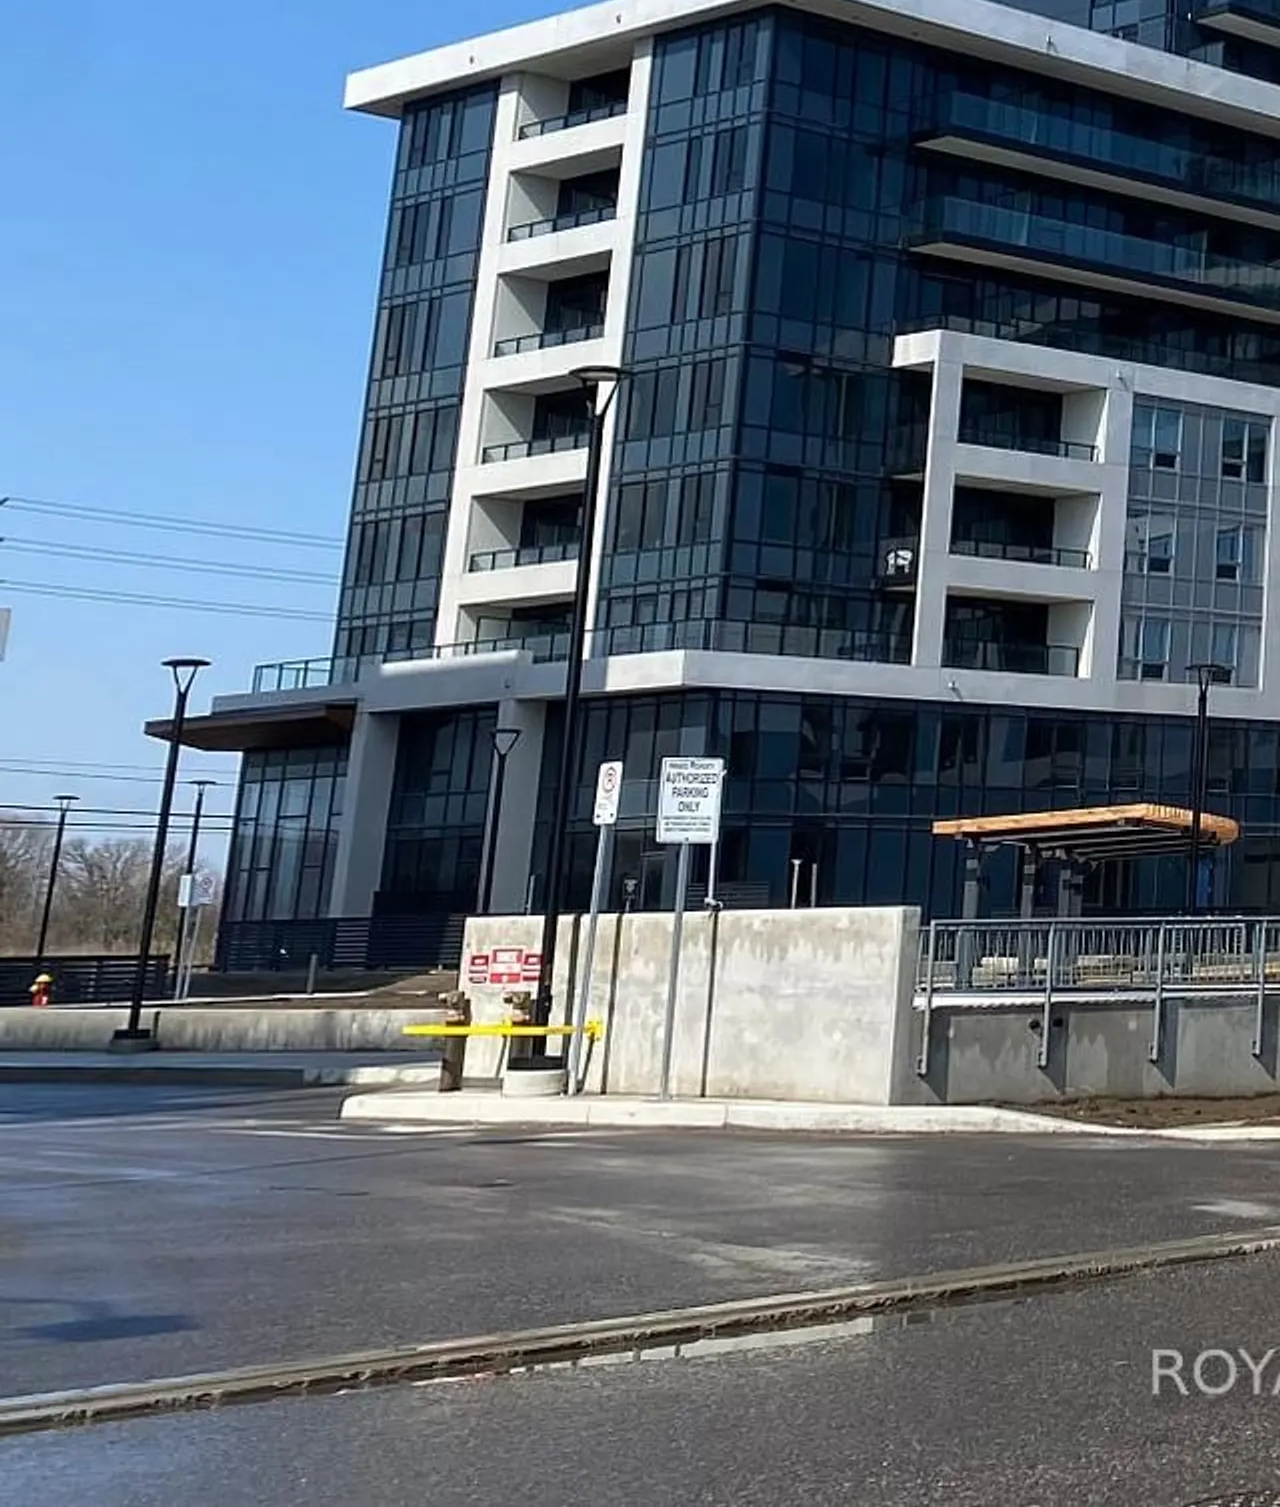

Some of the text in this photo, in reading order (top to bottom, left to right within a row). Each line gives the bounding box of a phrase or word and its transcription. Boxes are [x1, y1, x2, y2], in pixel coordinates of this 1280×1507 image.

[666, 772, 719, 785] AUTHORIZED
[672, 786, 709, 798] PARKING
[678, 800, 701, 812] ONLY
